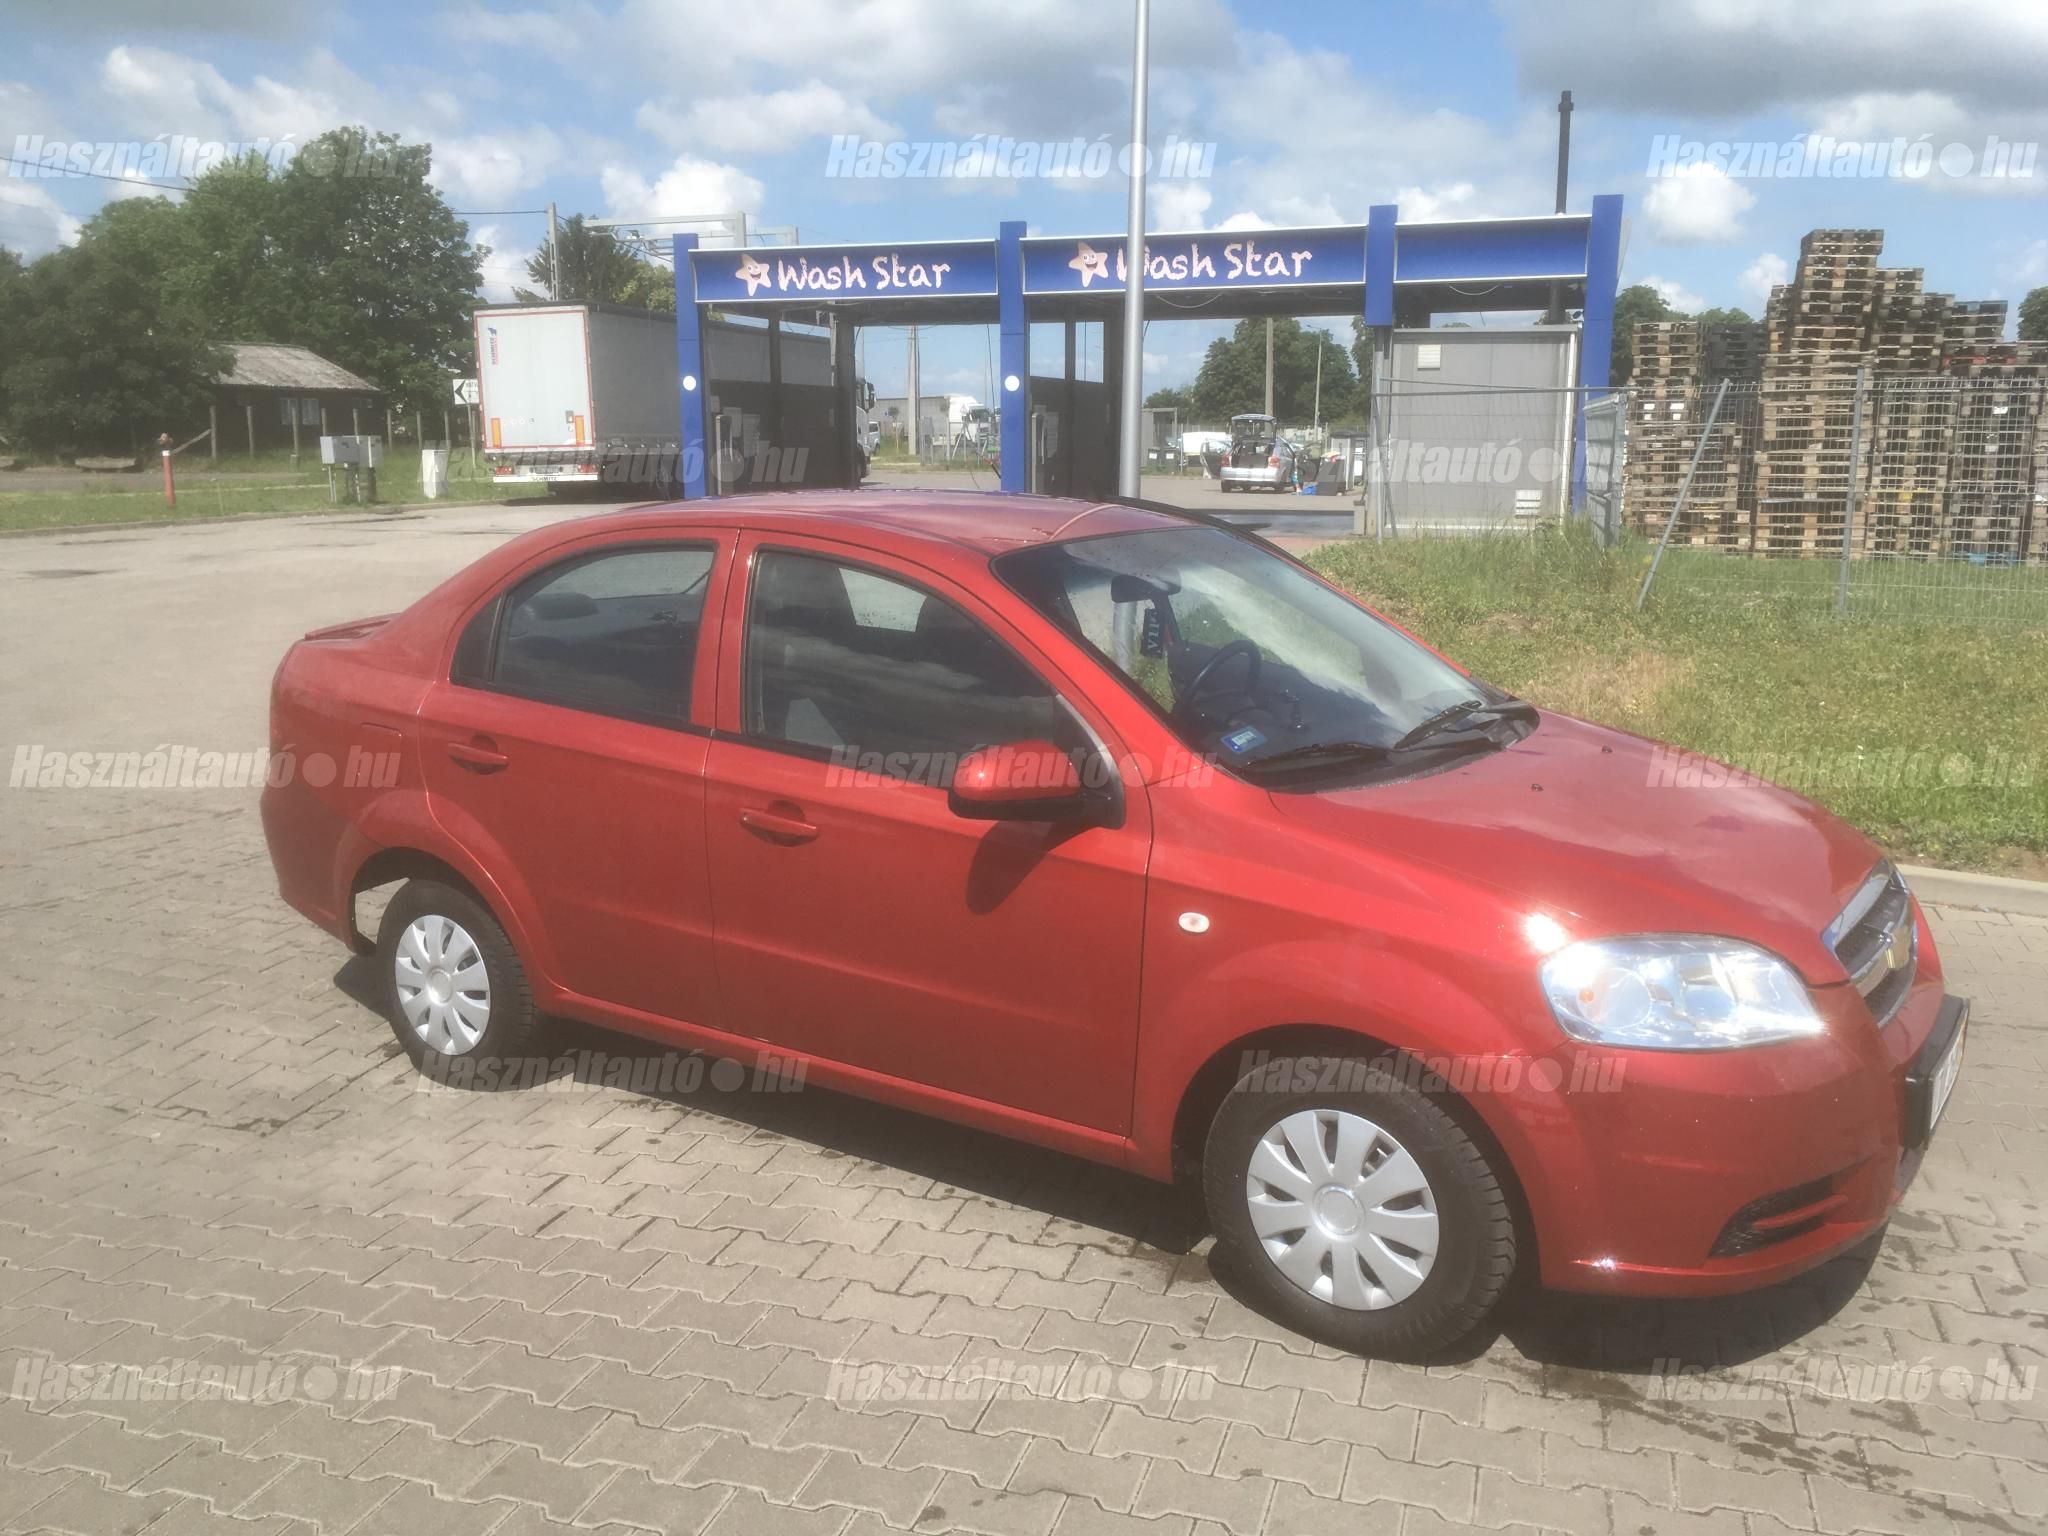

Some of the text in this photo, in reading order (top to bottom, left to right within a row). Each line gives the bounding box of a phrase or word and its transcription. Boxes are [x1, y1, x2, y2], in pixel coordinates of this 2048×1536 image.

[778, 253, 951, 291] Wash Star
[1224, 240, 1312, 280] Star
